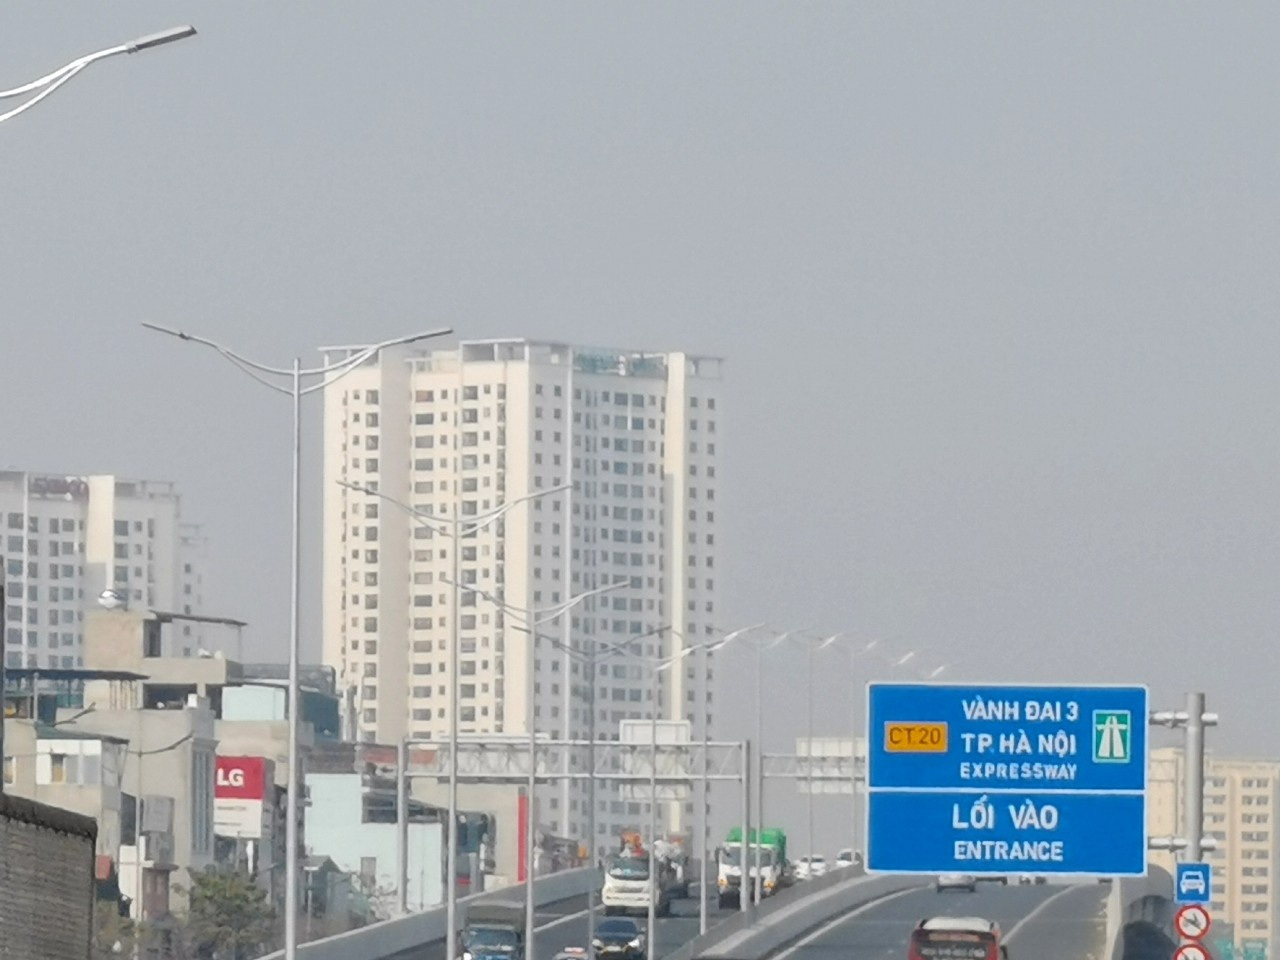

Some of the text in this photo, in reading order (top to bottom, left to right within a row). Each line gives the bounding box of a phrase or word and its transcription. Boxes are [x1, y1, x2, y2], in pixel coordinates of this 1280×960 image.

[962, 695, 1078, 721] VÀNH ĐAI 3
[999, 730, 1032, 754] HÀ
[1039, 730, 1076, 757] NỘI
[217, 767, 244, 787] LG
[960, 763, 1077, 780] EXPRESSWAY
[953, 795, 1058, 830] LỐI VÀO
[954, 841, 1063, 861] ENTRANCE
